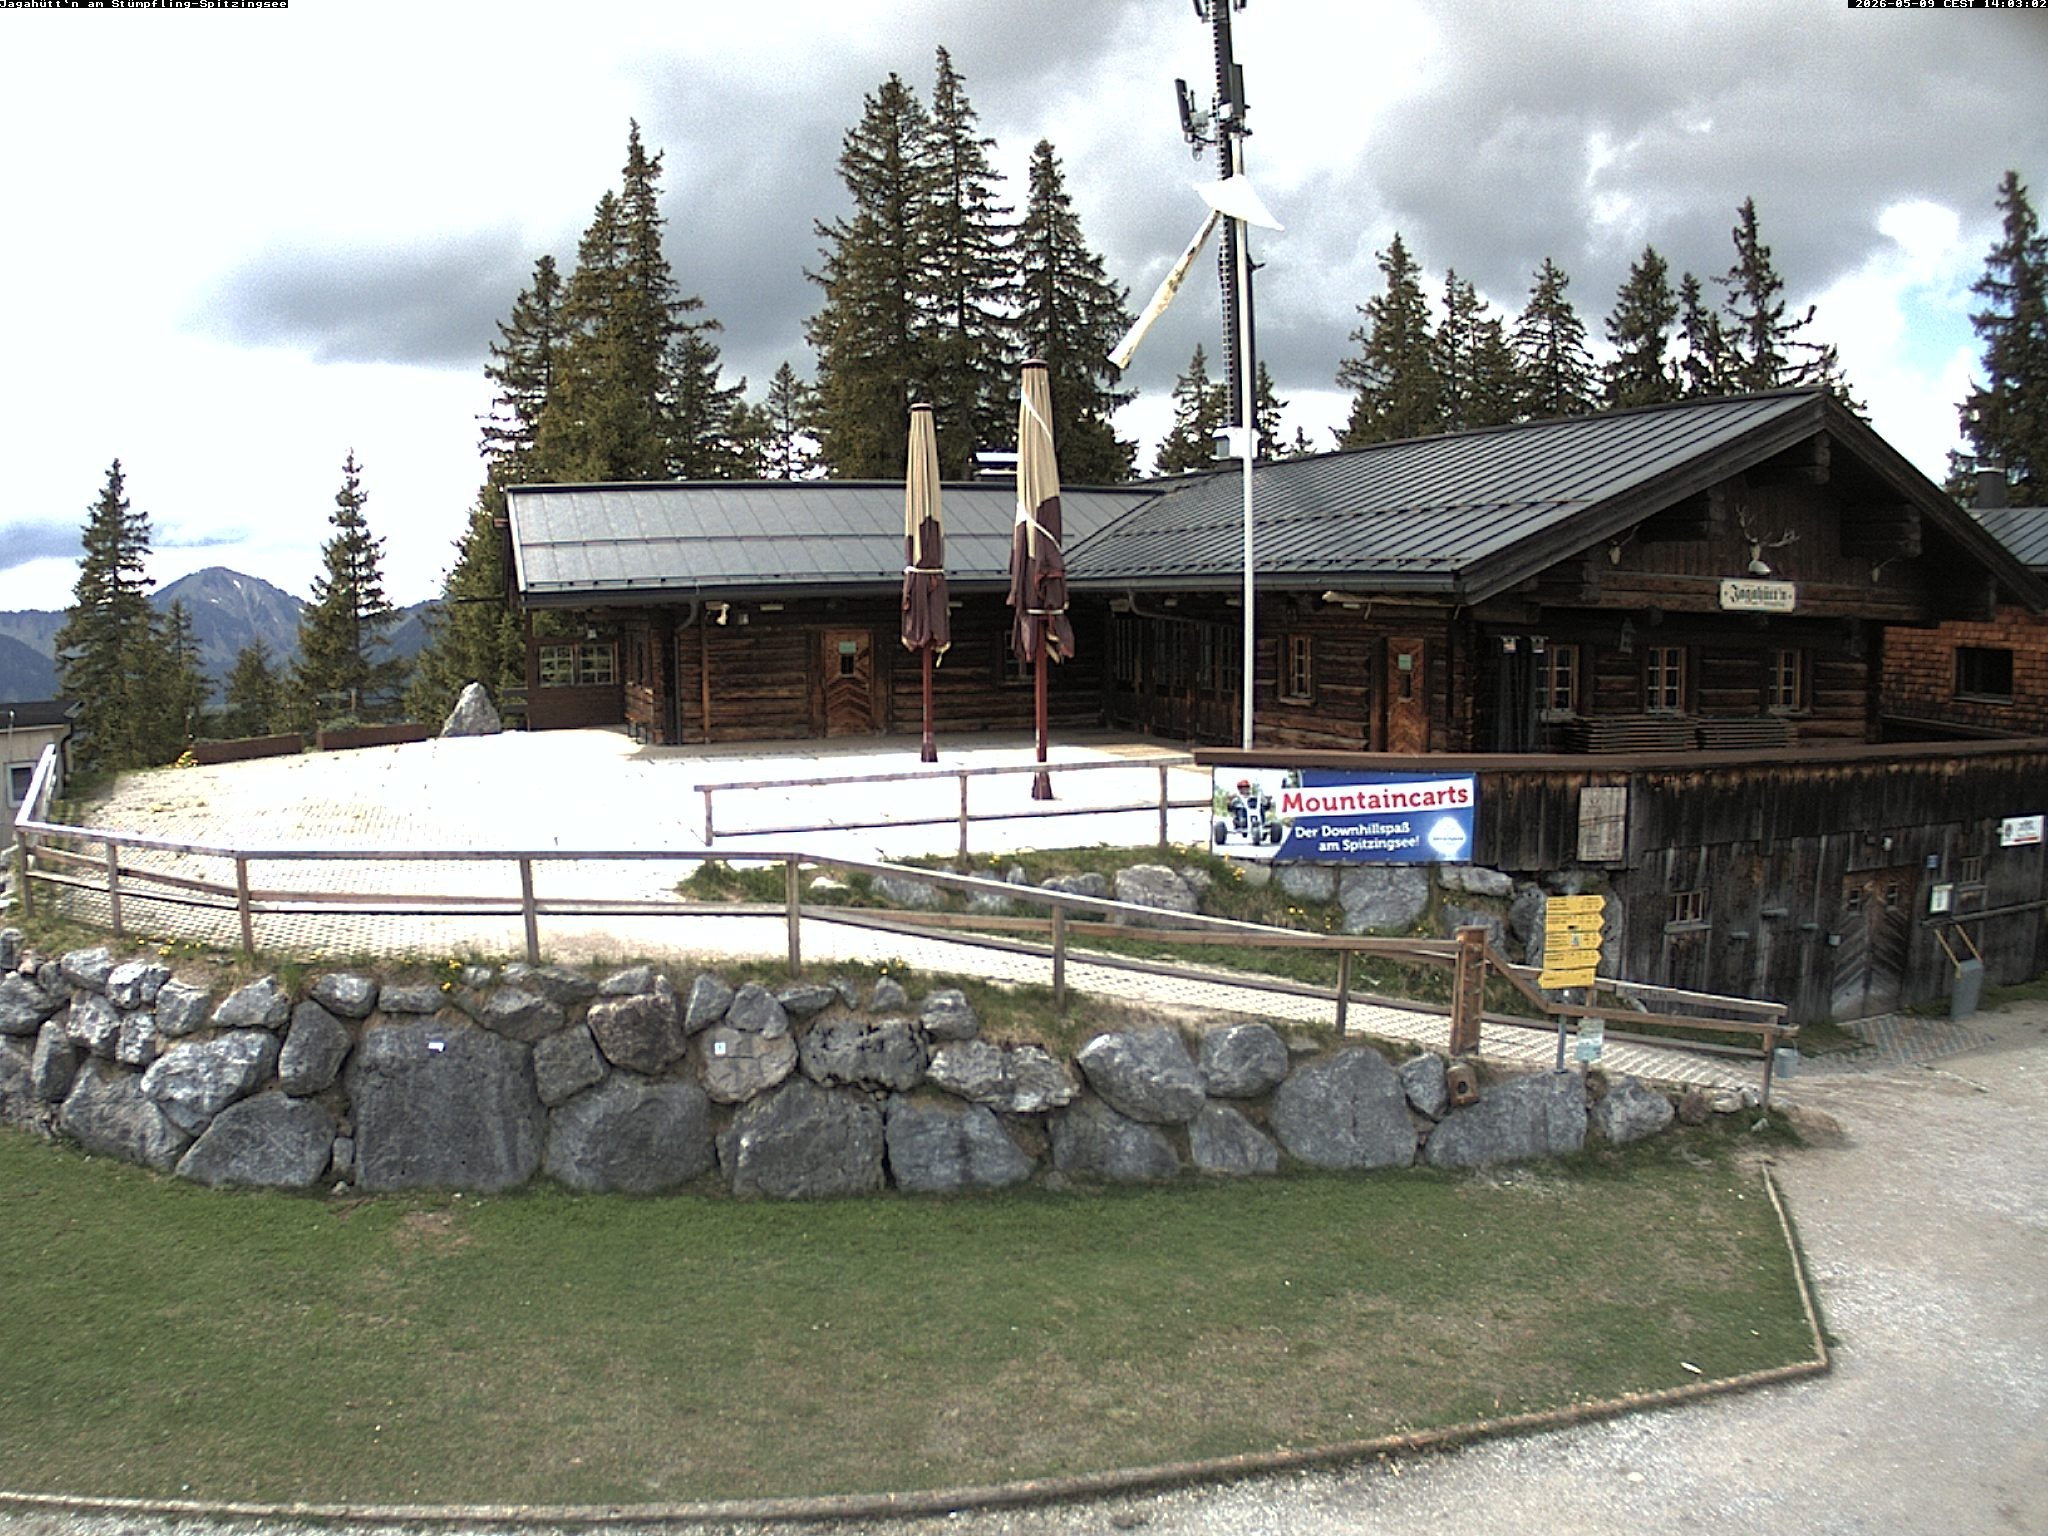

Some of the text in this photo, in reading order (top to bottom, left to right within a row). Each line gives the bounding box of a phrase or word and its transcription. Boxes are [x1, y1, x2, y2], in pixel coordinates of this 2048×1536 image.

[1281, 786, 1469, 813] Mountaincarts
[1295, 821, 1411, 838] Der Downhillspaß
[1318, 835, 1420, 852] am Spitzingsee!
